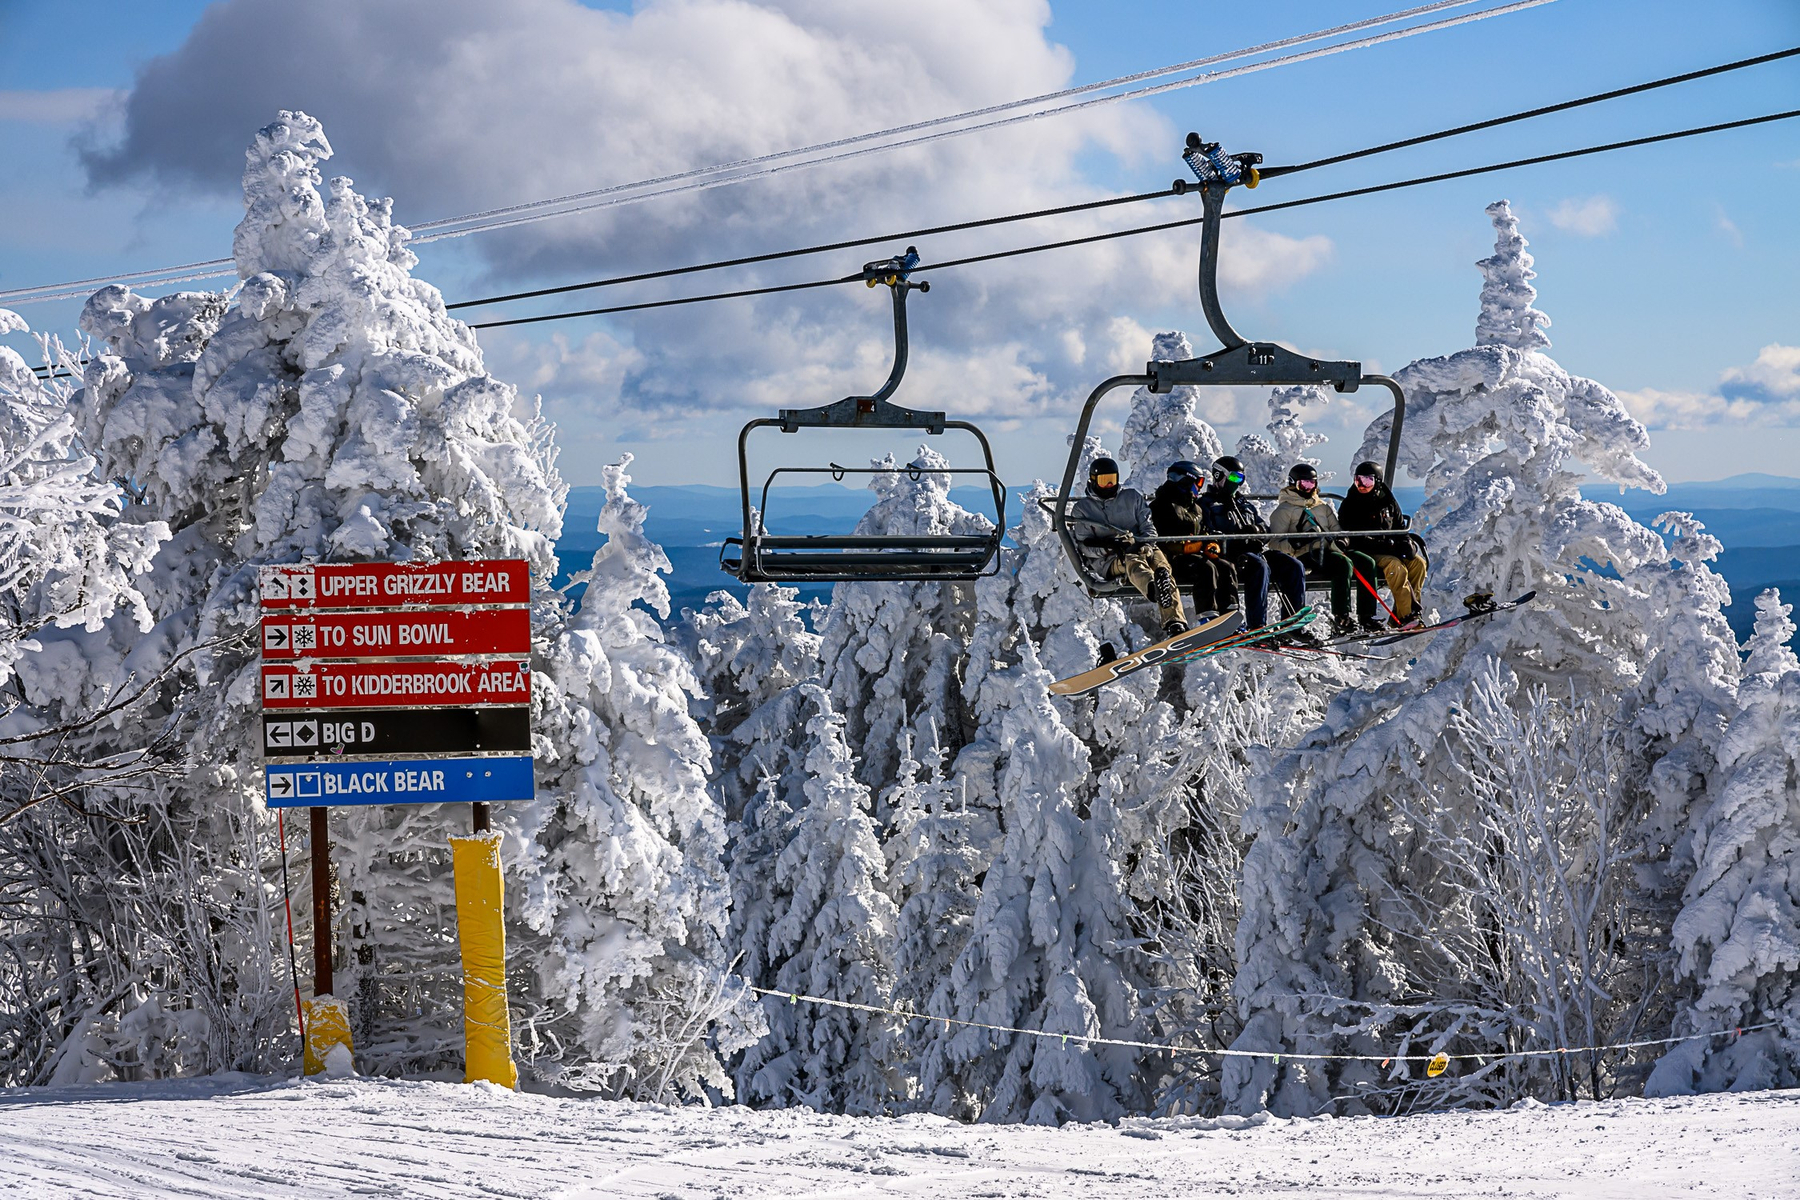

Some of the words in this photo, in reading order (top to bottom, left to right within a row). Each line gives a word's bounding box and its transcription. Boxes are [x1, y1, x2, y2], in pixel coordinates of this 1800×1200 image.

[320, 575, 378, 596] UPPER
[384, 573, 456, 595] GRIZZLY
[462, 572, 510, 593] BEAR
[320, 625, 346, 646] TO
[353, 625, 391, 646] SUN
[399, 624, 454, 644] BOWL
[322, 675, 346, 696] TO
[352, 673, 471, 695] KIDDERBROOK
[478, 672, 526, 693] AREA
[322, 723, 355, 743] BIG
[361, 722, 375, 742] D
[325, 772, 388, 794] BLACK
[394, 771, 445, 792] BEAR
